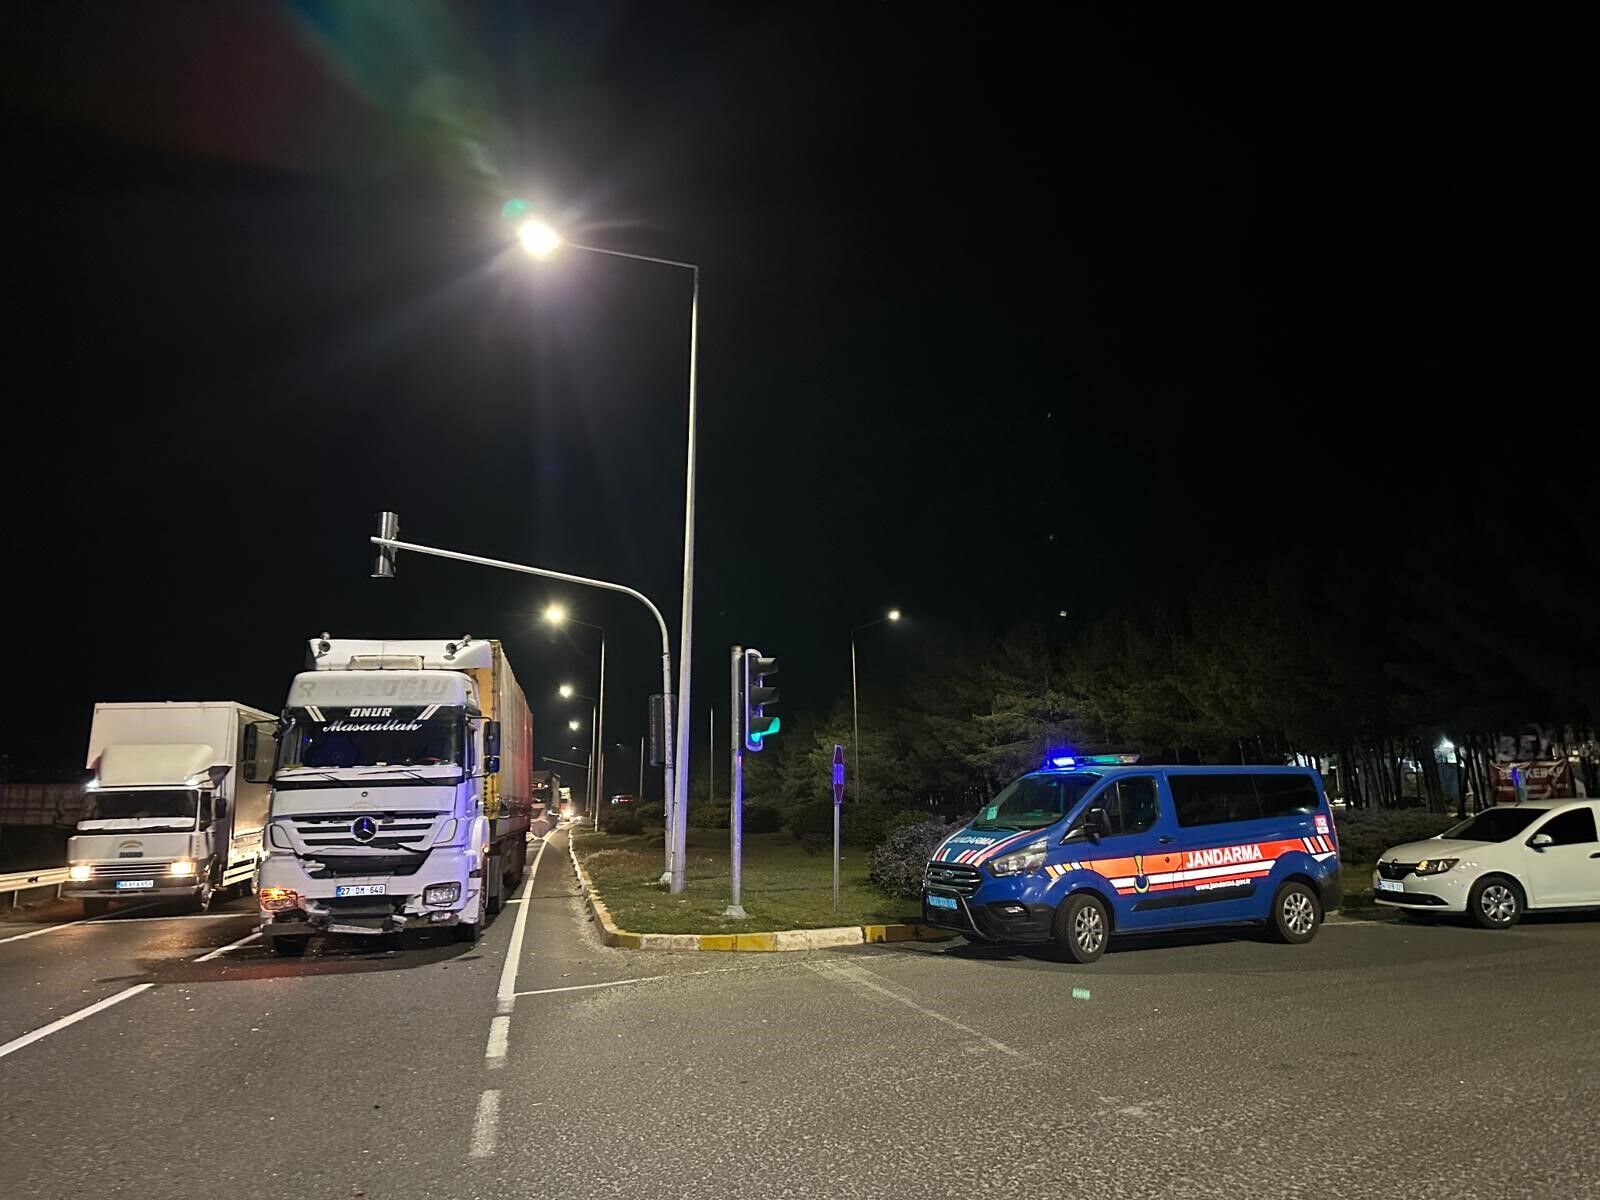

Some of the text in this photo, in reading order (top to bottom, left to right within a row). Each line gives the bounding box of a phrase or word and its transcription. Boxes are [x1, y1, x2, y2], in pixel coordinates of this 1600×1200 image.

[349, 707, 392, 717] ONUR
[1186, 845, 1263, 868] JANDARMA
[341, 887, 350, 895] 27
